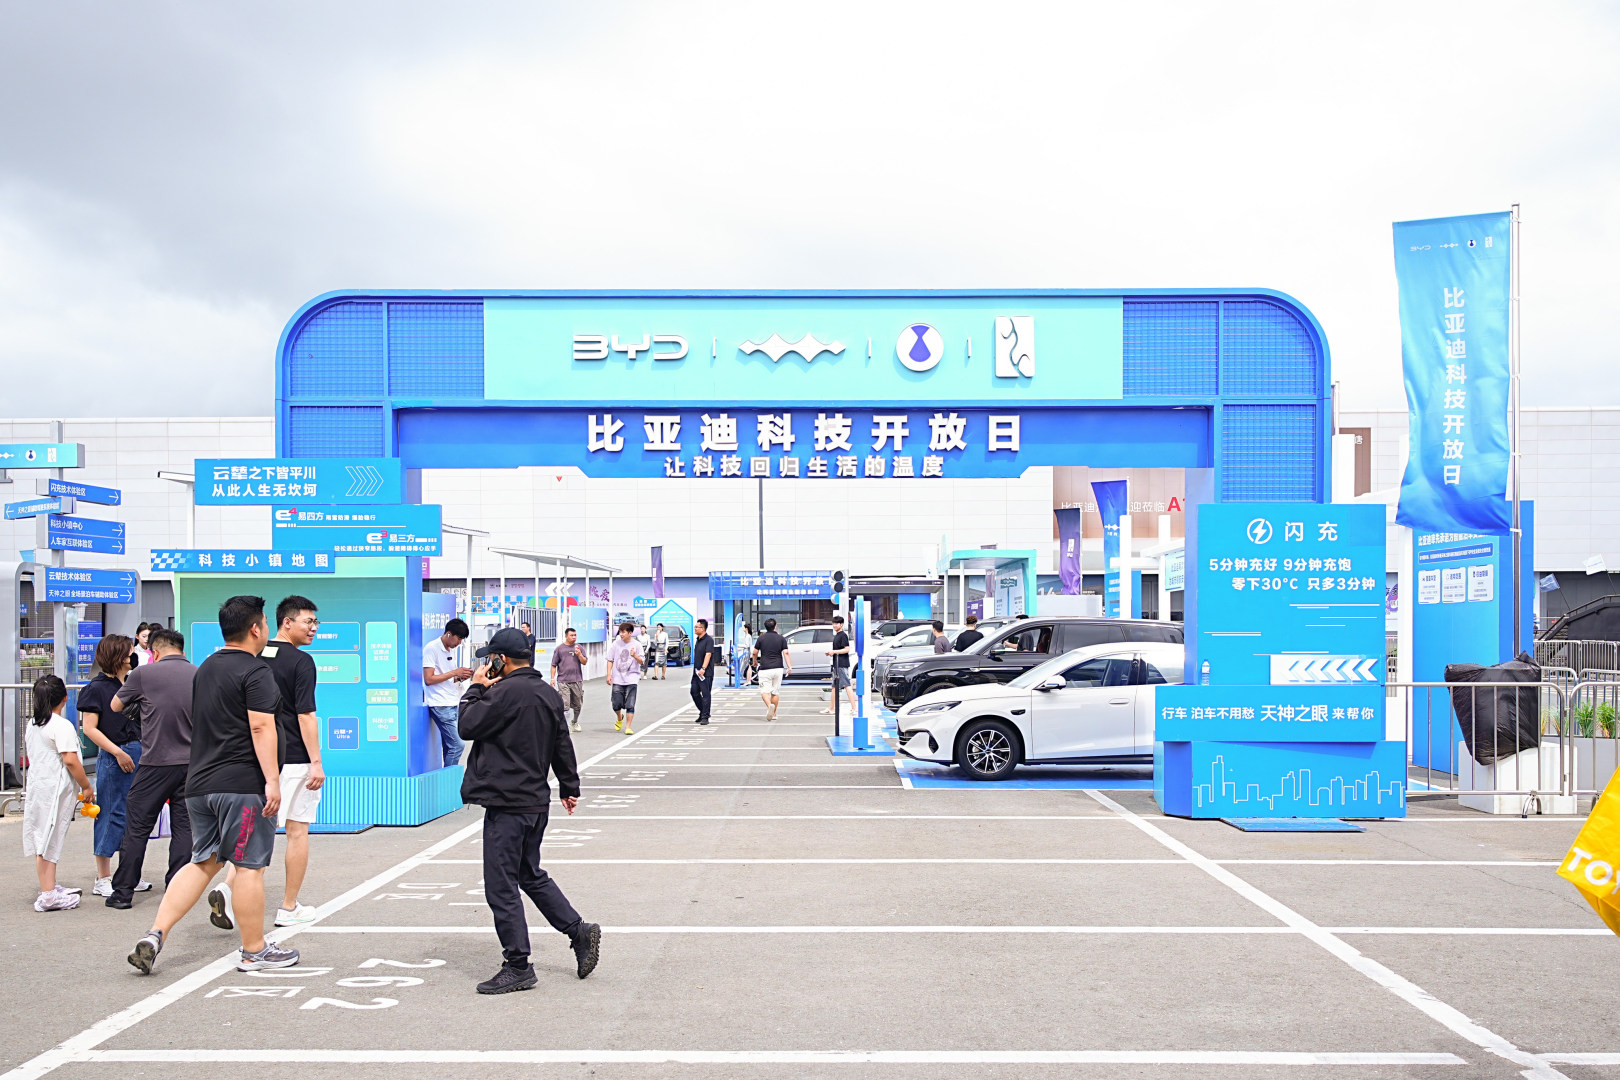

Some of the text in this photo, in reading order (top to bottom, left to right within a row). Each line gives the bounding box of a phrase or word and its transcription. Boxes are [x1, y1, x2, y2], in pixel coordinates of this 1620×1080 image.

[572, 334, 689, 360] BYD
[1443, 287, 1467, 485] 比亚迪科技开放日
[586, 413, 1021, 453] 比亚迪科技开放日
[213, 466, 316, 480] 云辇之下皆平川
[664, 455, 945, 478] 让科技回归生活的温度
[50, 482, 86, 496] 闪充技术体验区
[212, 483, 317, 497] 从此人生无坎坷
[1061, 501, 1165, 512] 比亚迪迎莅临
[298, 512, 324, 520] 易四方
[50, 519, 83, 530] 科技小镇中心
[1284, 521, 1338, 542] 闪充
[50, 536, 93, 549] 人车家互联体验区
[389, 534, 415, 543] 易三方
[199, 553, 329, 567] 科技小镇地图
[1209, 558, 1351, 571] 5分钟充好 9分钟充饱
[1307, 577, 1376, 591] 只多3分钟
[1161, 705, 1375, 722] 行车 泊车不用愁 天神之眼 来帮你
[234, 805, 250, 860] ARMOUR
[203, 967, 335, 998] D区
[299, 958, 447, 1010] 262
